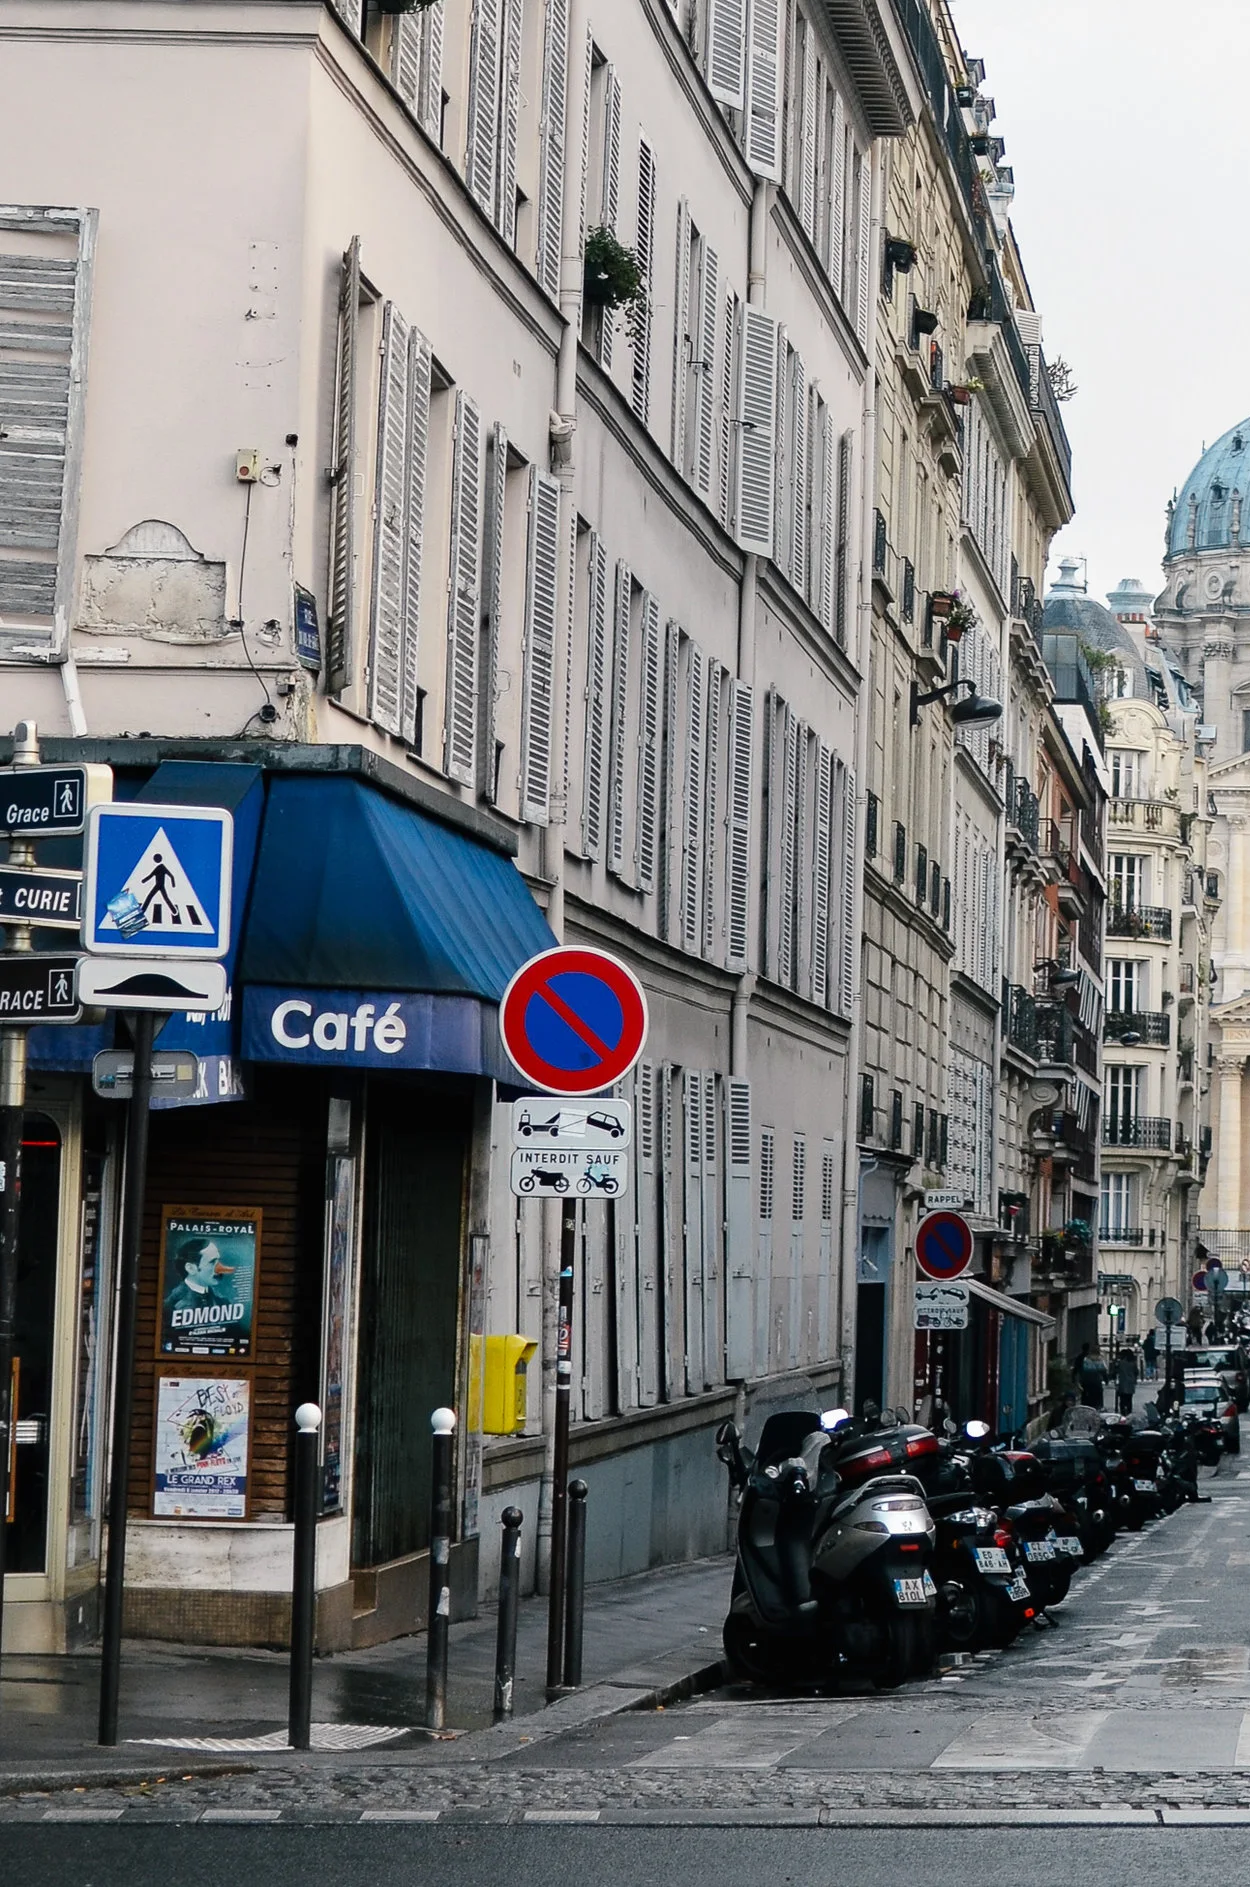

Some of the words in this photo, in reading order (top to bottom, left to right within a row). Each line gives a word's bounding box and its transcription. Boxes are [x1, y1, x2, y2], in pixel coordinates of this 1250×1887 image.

[6, 803, 49, 824] Grace
[14, 887, 71, 912] CURIE
[271, 1000, 406, 1054] Café
[520, 1153, 579, 1164] INTERDIT
[586, 1154, 620, 1165] SAUF
[927, 1195, 961, 1204] RAPPEL
[171, 1303, 245, 1328] EDMOND
[196, 1383, 230, 1408] BEST
[214, 1402, 245, 1418] FLOYD
[167, 1474, 179, 1484] LE
[181, 1475, 215, 1485] GRAND
[217, 1477, 237, 1486] REX
[905, 1580, 920, 1591] AX
